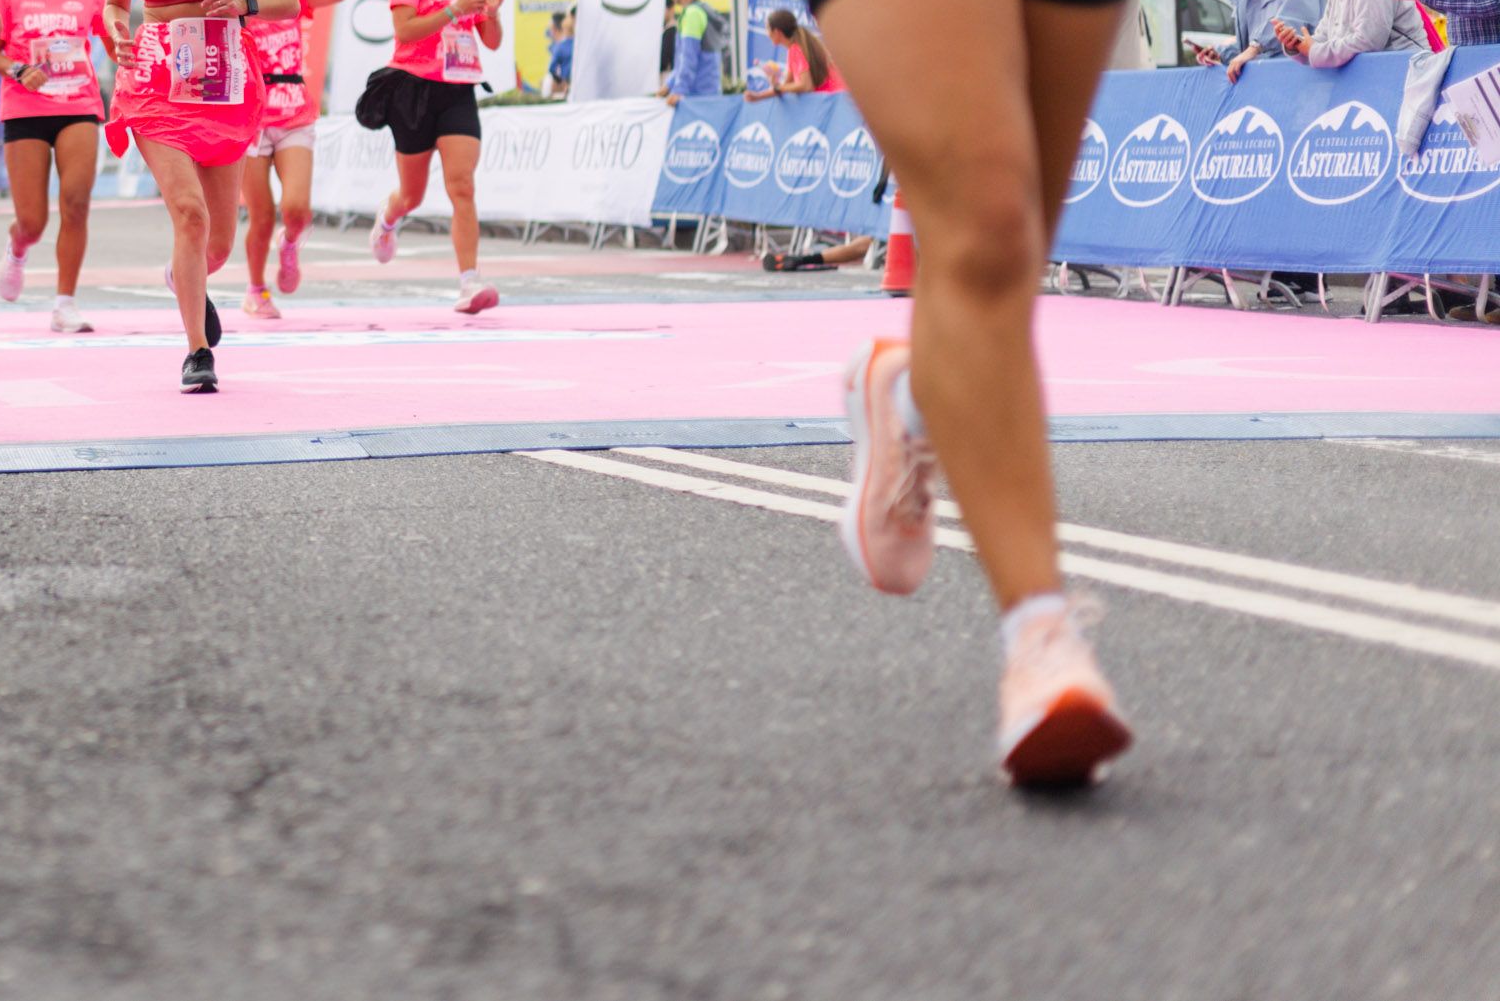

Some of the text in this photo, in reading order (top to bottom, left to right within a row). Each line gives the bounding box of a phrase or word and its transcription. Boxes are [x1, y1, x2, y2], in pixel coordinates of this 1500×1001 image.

[24, 14, 78, 31] CARRERA
[205, 45, 219, 77] 016
[483, 125, 550, 172] OYSHO
[573, 122, 645, 170] OYSHO
[1244, 139, 1276, 149] LECHERA
[1315, 135, 1384, 146] CENTRAL LECHERA
[1113, 149, 1182, 183] ASTURIANA
[1196, 145, 1273, 180] ASTURIANA
[1294, 140, 1381, 177] ASTURIANA
[1401, 147, 1500, 176] ASTURIA
